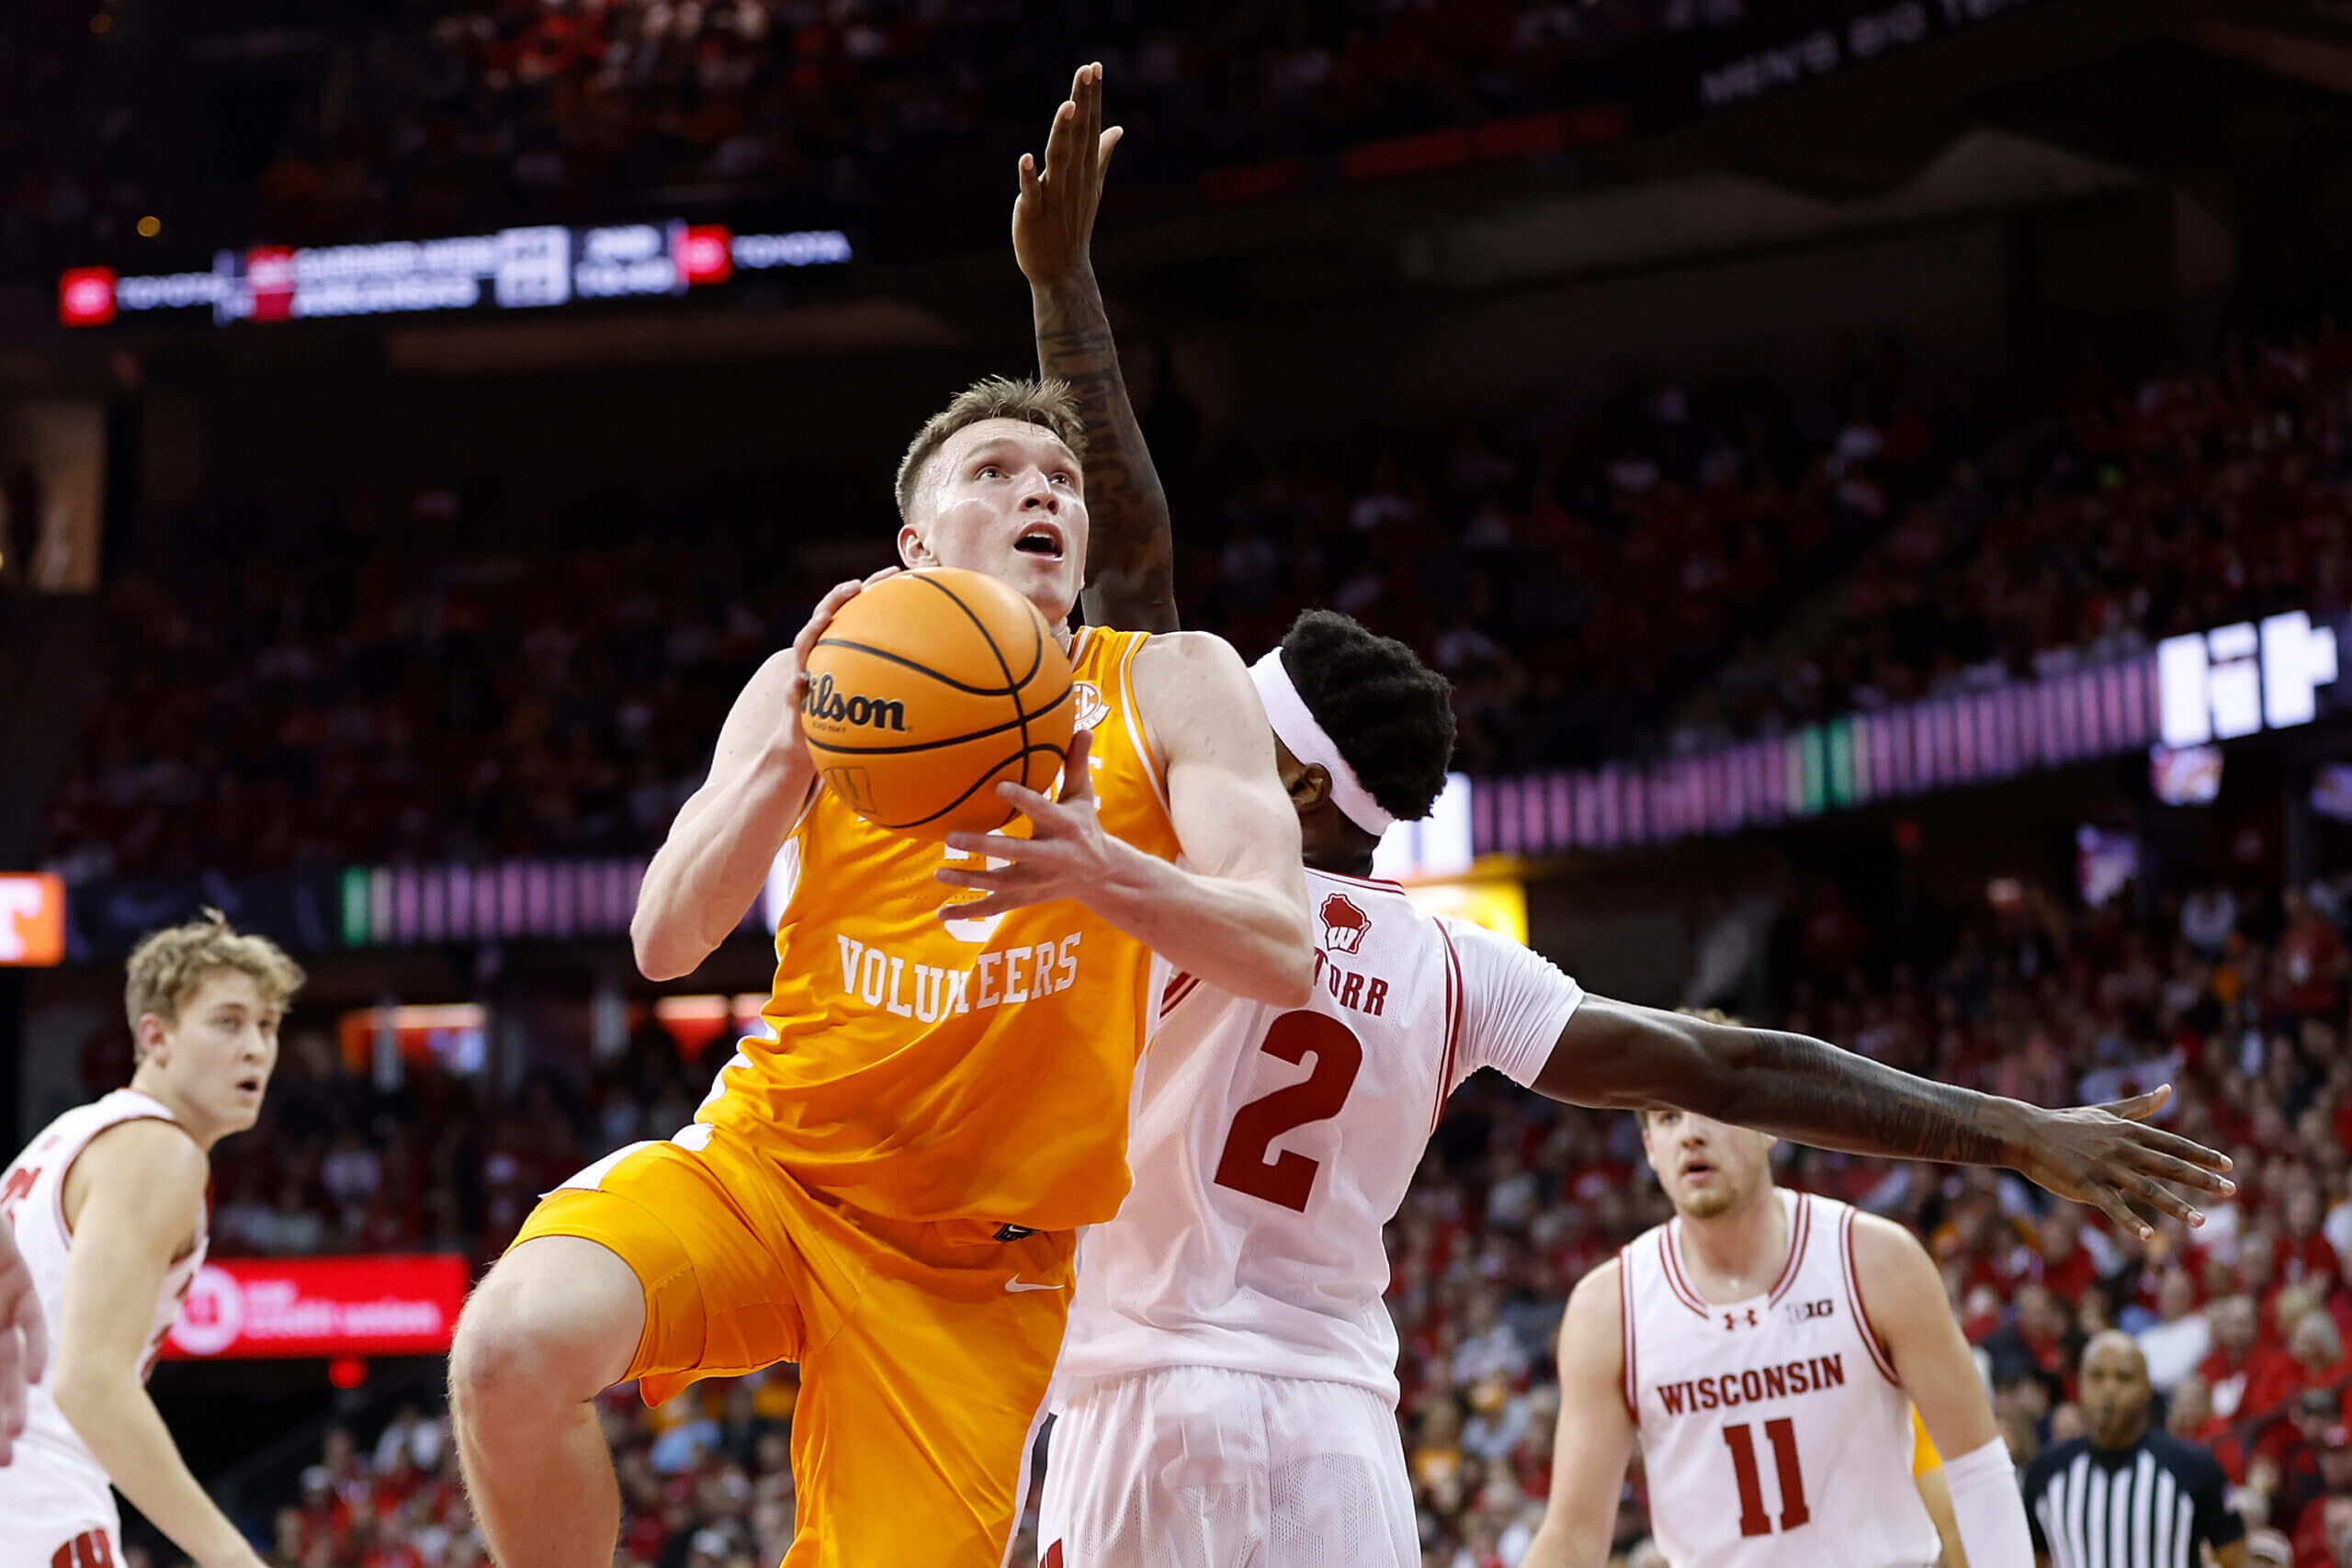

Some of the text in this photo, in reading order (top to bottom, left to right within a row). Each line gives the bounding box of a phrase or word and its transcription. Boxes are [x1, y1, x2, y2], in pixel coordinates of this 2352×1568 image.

[801, 671, 907, 732] ilson
[1315, 945, 1389, 1017] TORR
[1214, 1010, 1363, 1213] 2
[1657, 1353, 1845, 1416] WISCONSIN
[1721, 1416, 1811, 1537] 11
